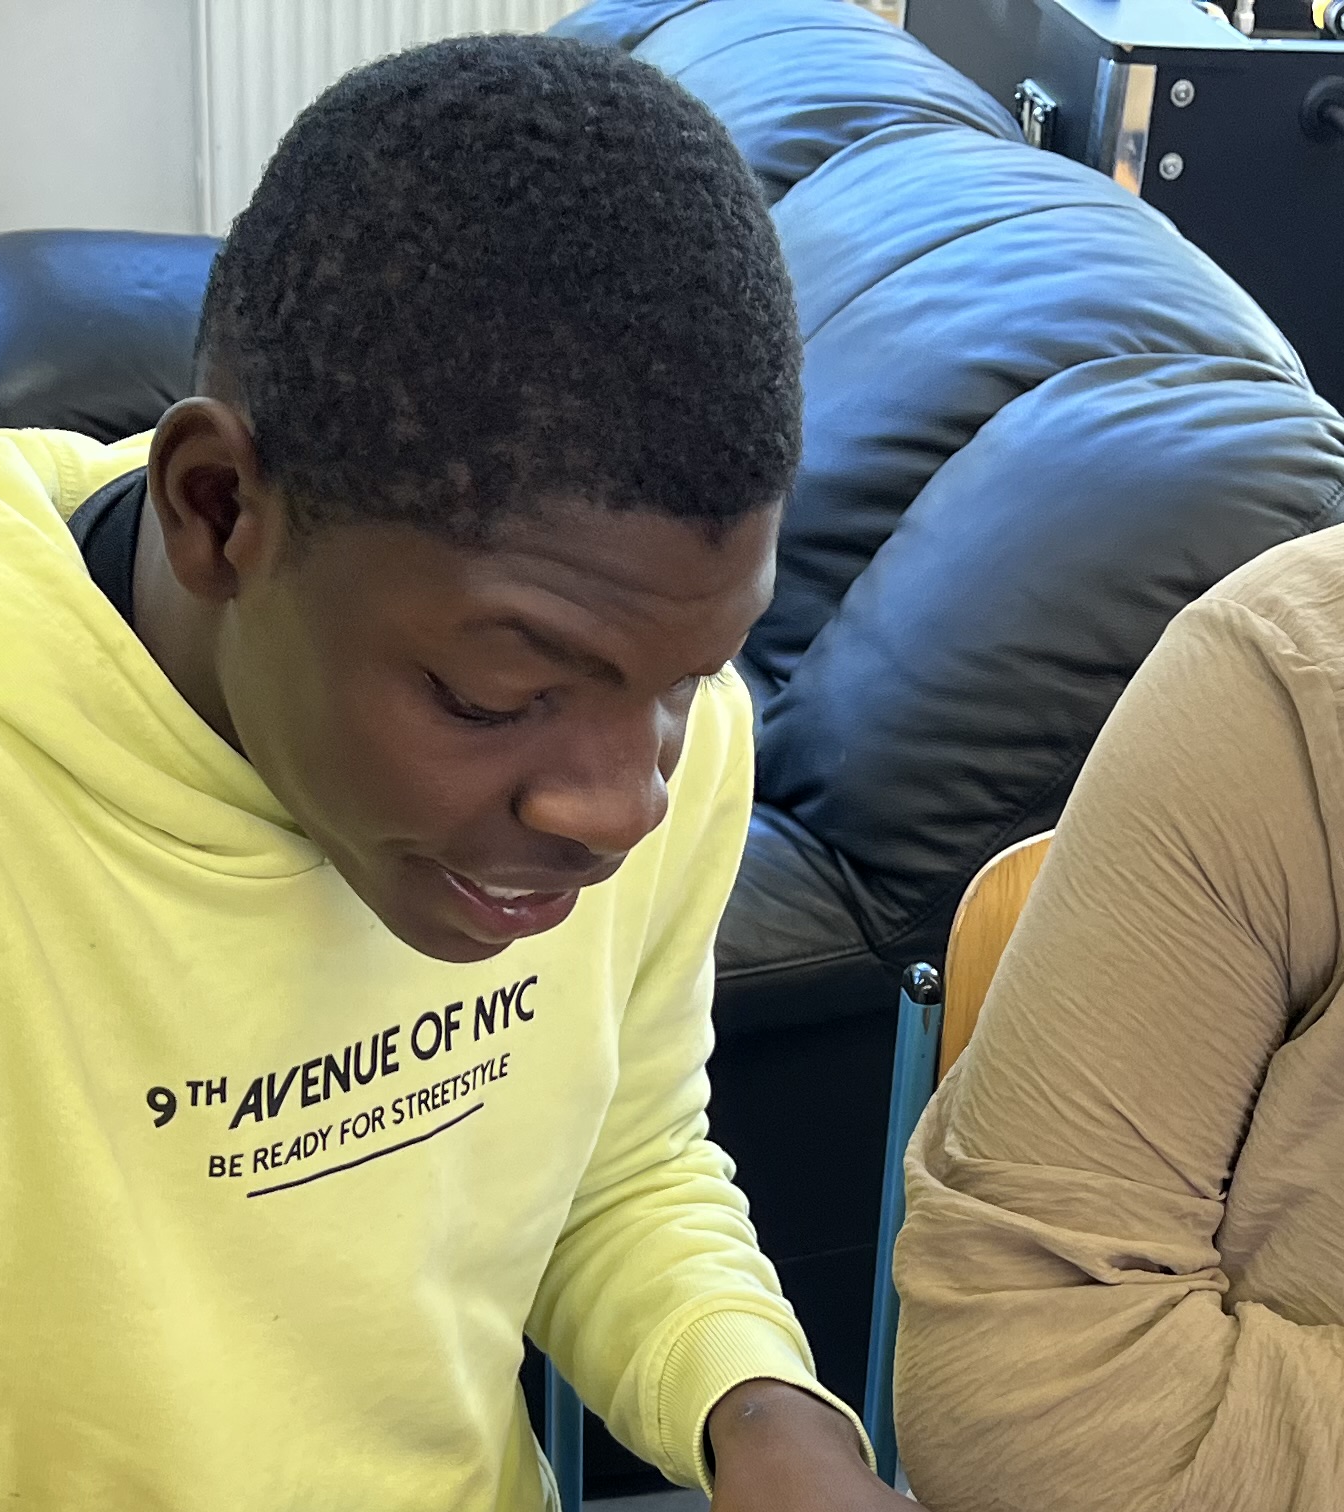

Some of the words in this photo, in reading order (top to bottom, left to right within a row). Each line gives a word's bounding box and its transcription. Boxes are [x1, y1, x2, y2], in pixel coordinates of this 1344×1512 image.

[208, 1154, 244, 1178] BE
[253, 1125, 333, 1174] READY
[339, 1106, 386, 1146] FOR
[391, 1053, 510, 1125] STREETSTYLE
[229, 1025, 400, 1130] AVENUE
[410, 1002, 463, 1061] OF
[473, 975, 538, 1042] NYC
